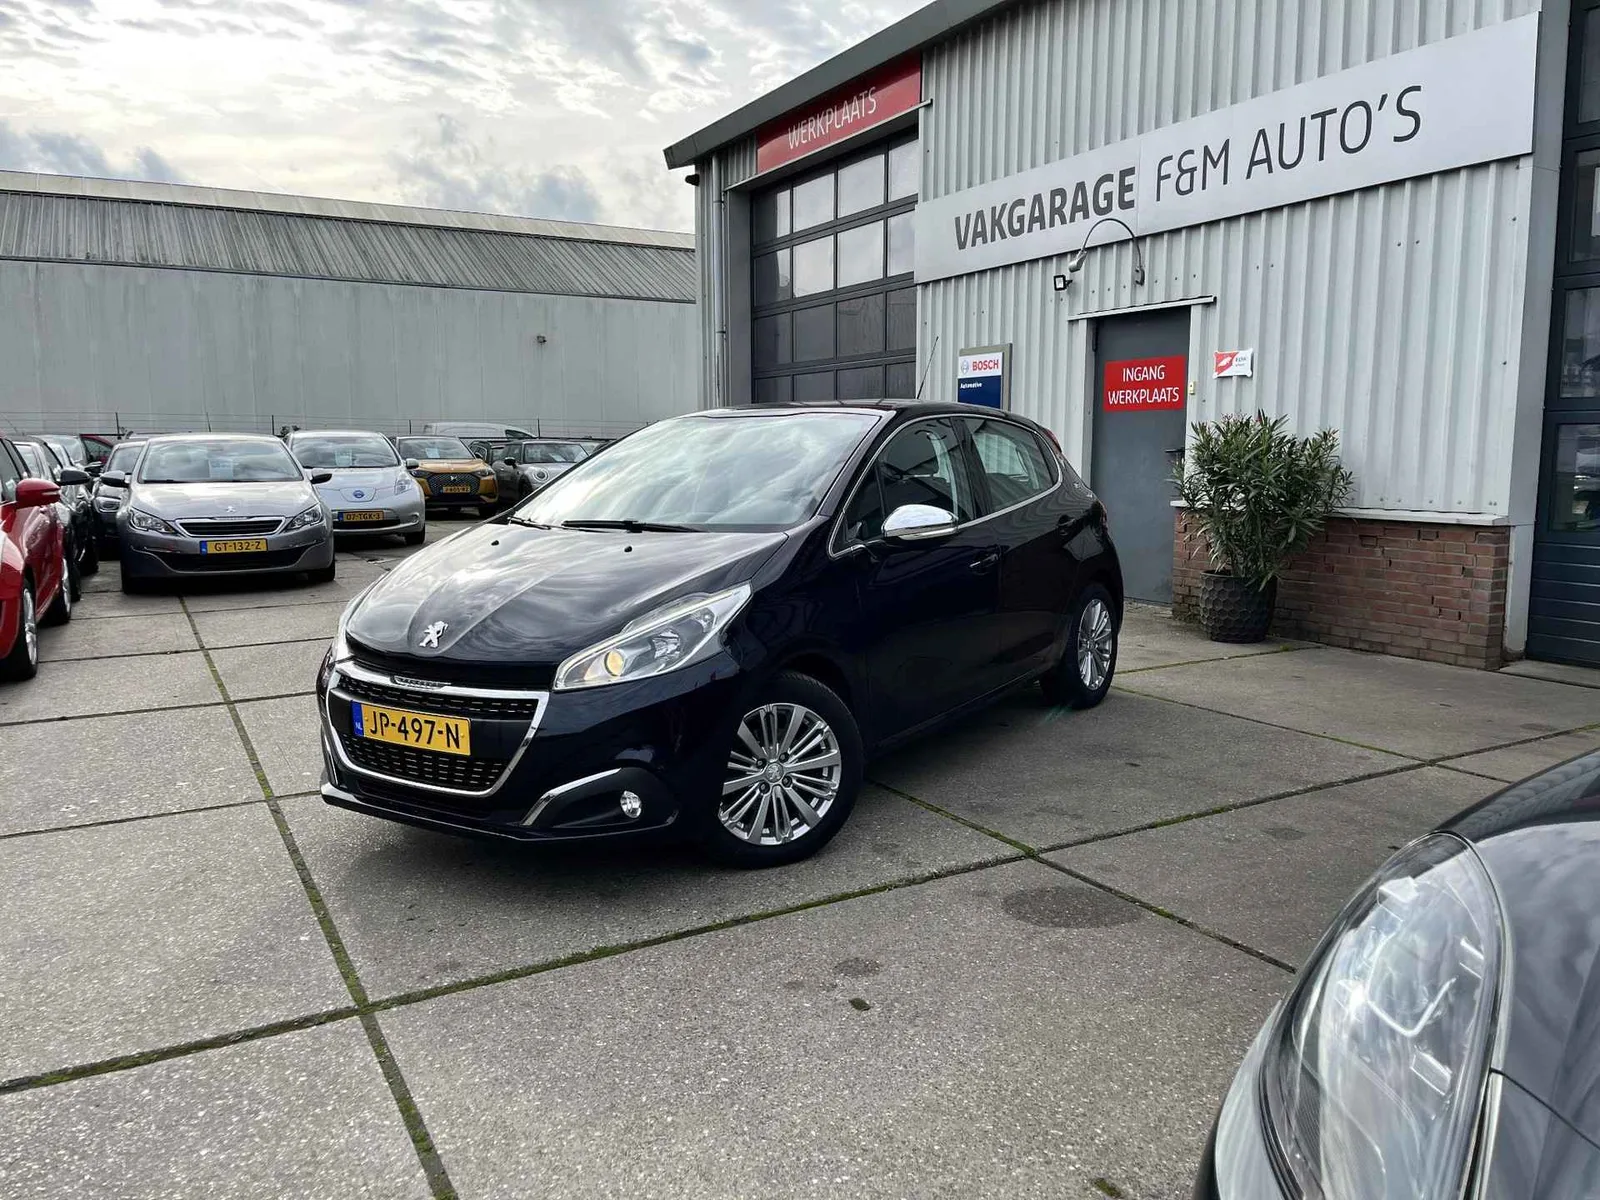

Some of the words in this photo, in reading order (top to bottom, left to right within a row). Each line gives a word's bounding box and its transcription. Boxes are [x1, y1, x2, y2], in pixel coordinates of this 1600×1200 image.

[788, 86, 877, 149] WERKPLAATS
[954, 166, 1136, 250] VAKGARAGE
[1156, 138, 1230, 202] F&M
[1245, 85, 1422, 180] AUTO'S
[972, 359, 999, 371] BOSCH
[1122, 364, 1166, 382] INGANG
[1108, 386, 1180, 405] WERKPLAATS
[346, 512, 381, 521] 07-TGK-3
[214, 541, 262, 552] GT-132-Z
[370, 710, 460, 750] JP-497-N
